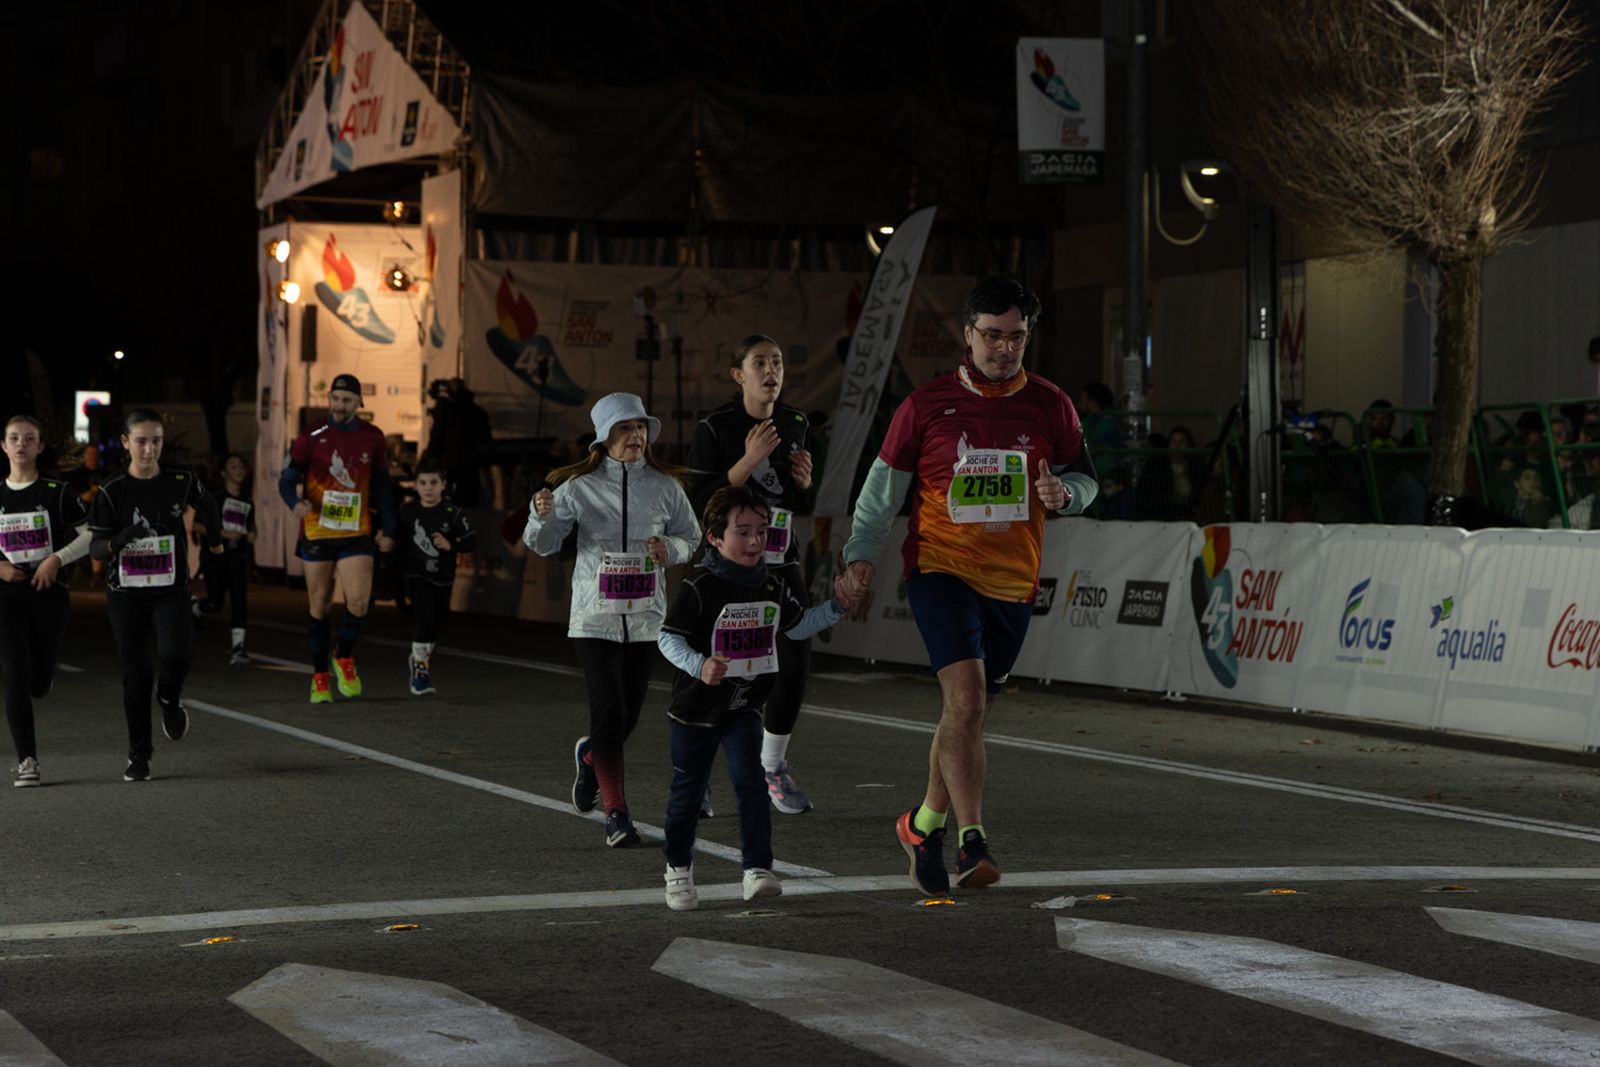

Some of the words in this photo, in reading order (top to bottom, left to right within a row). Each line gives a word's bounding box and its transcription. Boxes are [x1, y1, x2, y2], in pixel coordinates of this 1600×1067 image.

[1030, 153, 1096, 164] DACIA
[963, 474, 1012, 497] 2758
[606, 574, 652, 593] 15032
[1236, 569, 1282, 612] SAN
[1072, 587, 1107, 608] FISIO
[1127, 588, 1164, 602] DACIA
[721, 620, 737, 629] SAN
[1201, 586, 1231, 650] 43
[1225, 607, 1304, 663] ANTÓN
[1436, 618, 1506, 670] aqualia
